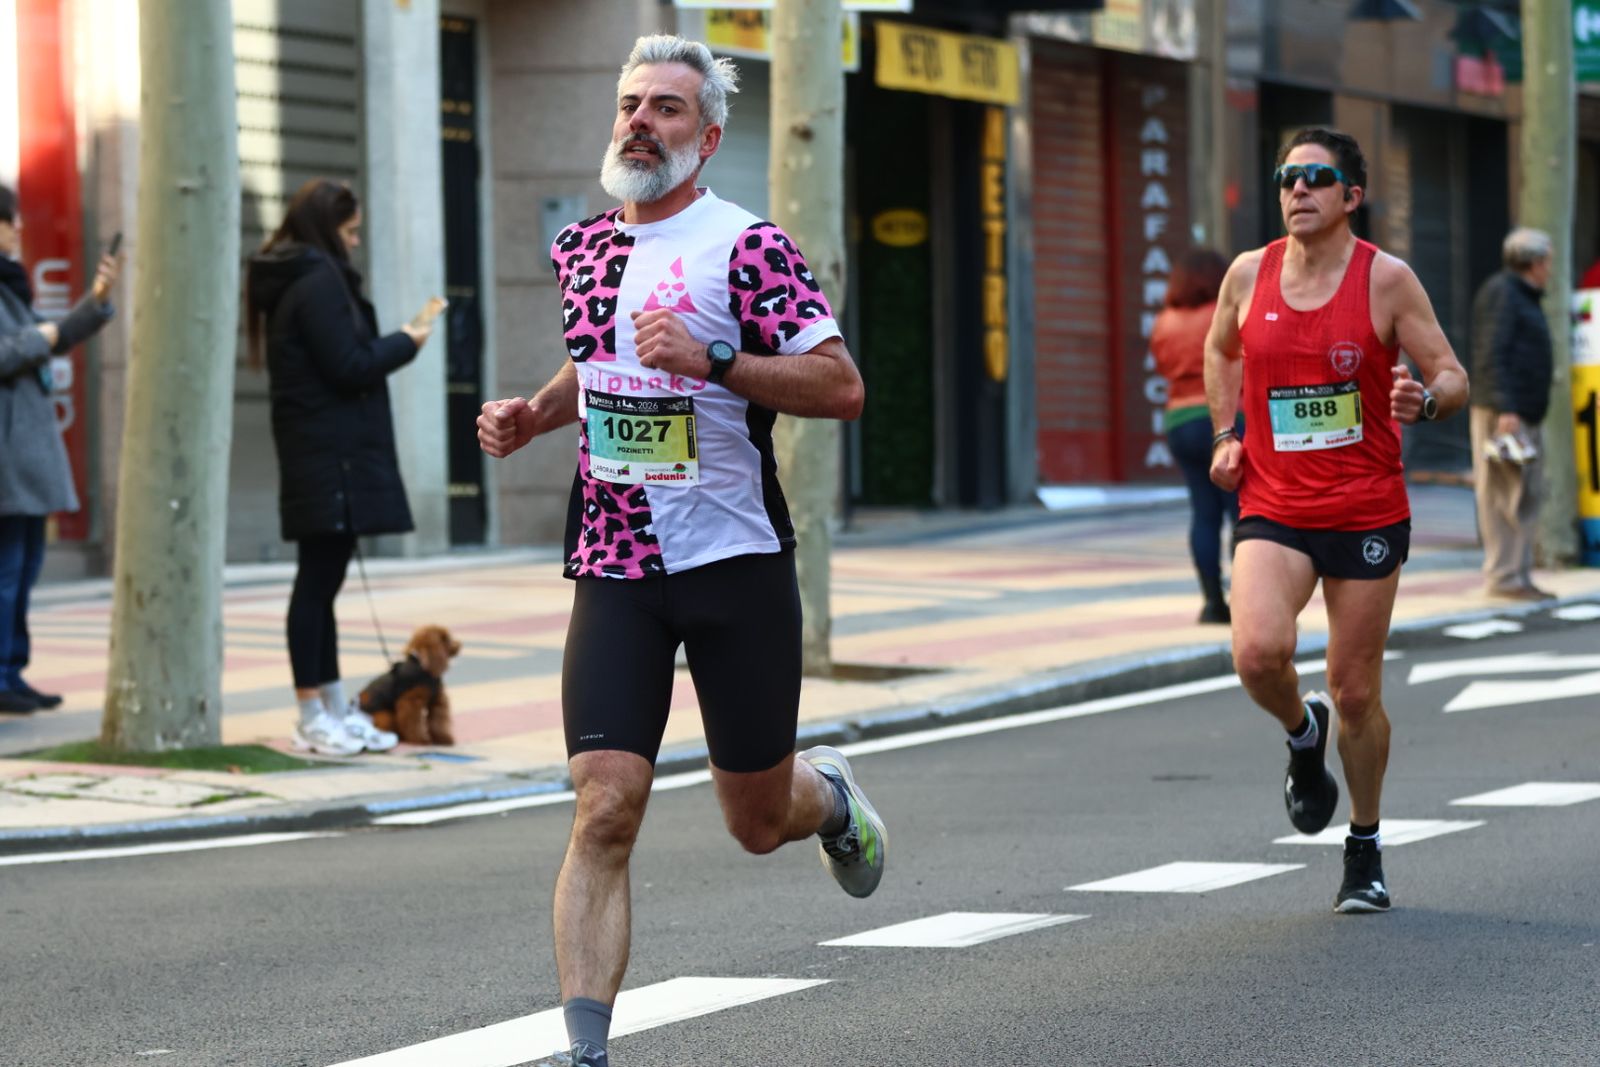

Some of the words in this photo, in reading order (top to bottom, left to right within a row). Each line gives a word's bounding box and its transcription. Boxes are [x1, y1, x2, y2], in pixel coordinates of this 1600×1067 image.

[1140, 84, 1174, 467] PARAFARCIA
[637, 401, 659, 410] 2026
[1294, 400, 1338, 419] 888
[603, 416, 671, 442] 1027
[617, 446, 654, 455] POZINETTI
